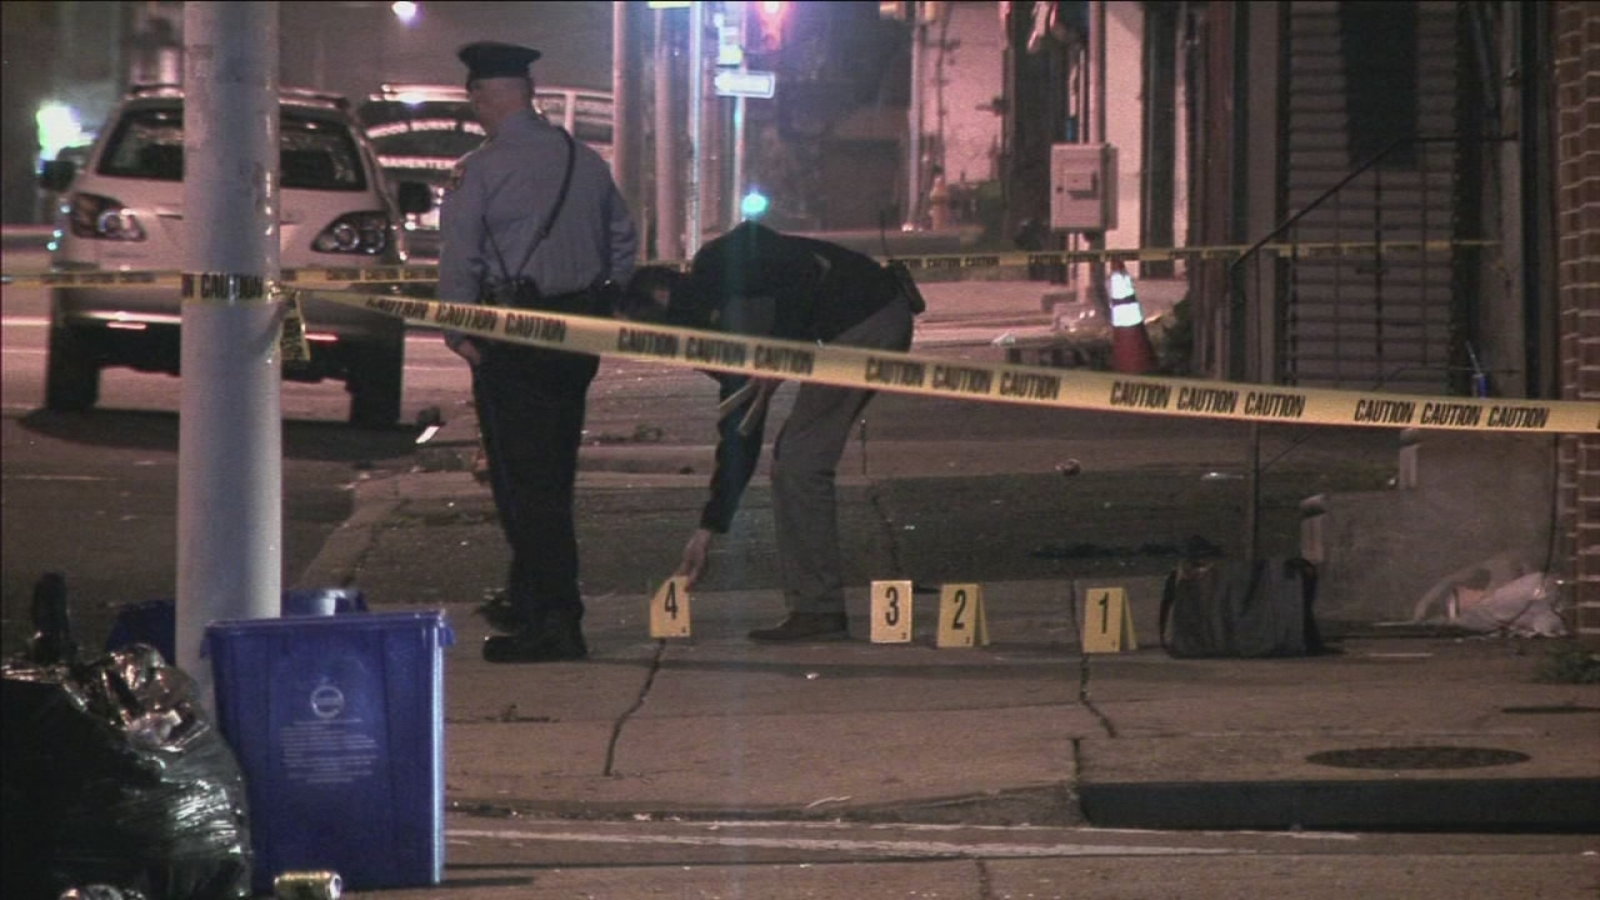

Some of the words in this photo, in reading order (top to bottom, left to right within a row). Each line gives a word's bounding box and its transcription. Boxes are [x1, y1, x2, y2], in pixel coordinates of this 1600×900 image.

[435, 303, 497, 331] CAUTION
[505, 313, 567, 342] CAUTION
[617, 327, 679, 357] CAUTION
[686, 337, 747, 367] CAUTION
[754, 344, 815, 375] CAUTION
[865, 356, 926, 387] CAUTION
[933, 364, 994, 393] CAUTION
[1000, 371, 1061, 400] CAUTION
[1110, 381, 1172, 409] CAUTION
[1176, 386, 1239, 414] CAUTION
[1244, 392, 1306, 418] CAUTION
[1354, 399, 1416, 424] CAUTION
[1420, 402, 1482, 426] CAUTION
[1487, 405, 1549, 428] CAUTION
[664, 581, 679, 620] 4
[885, 586, 899, 626] 3
[952, 589, 966, 630] 2
[1099, 592, 1110, 634] 1
